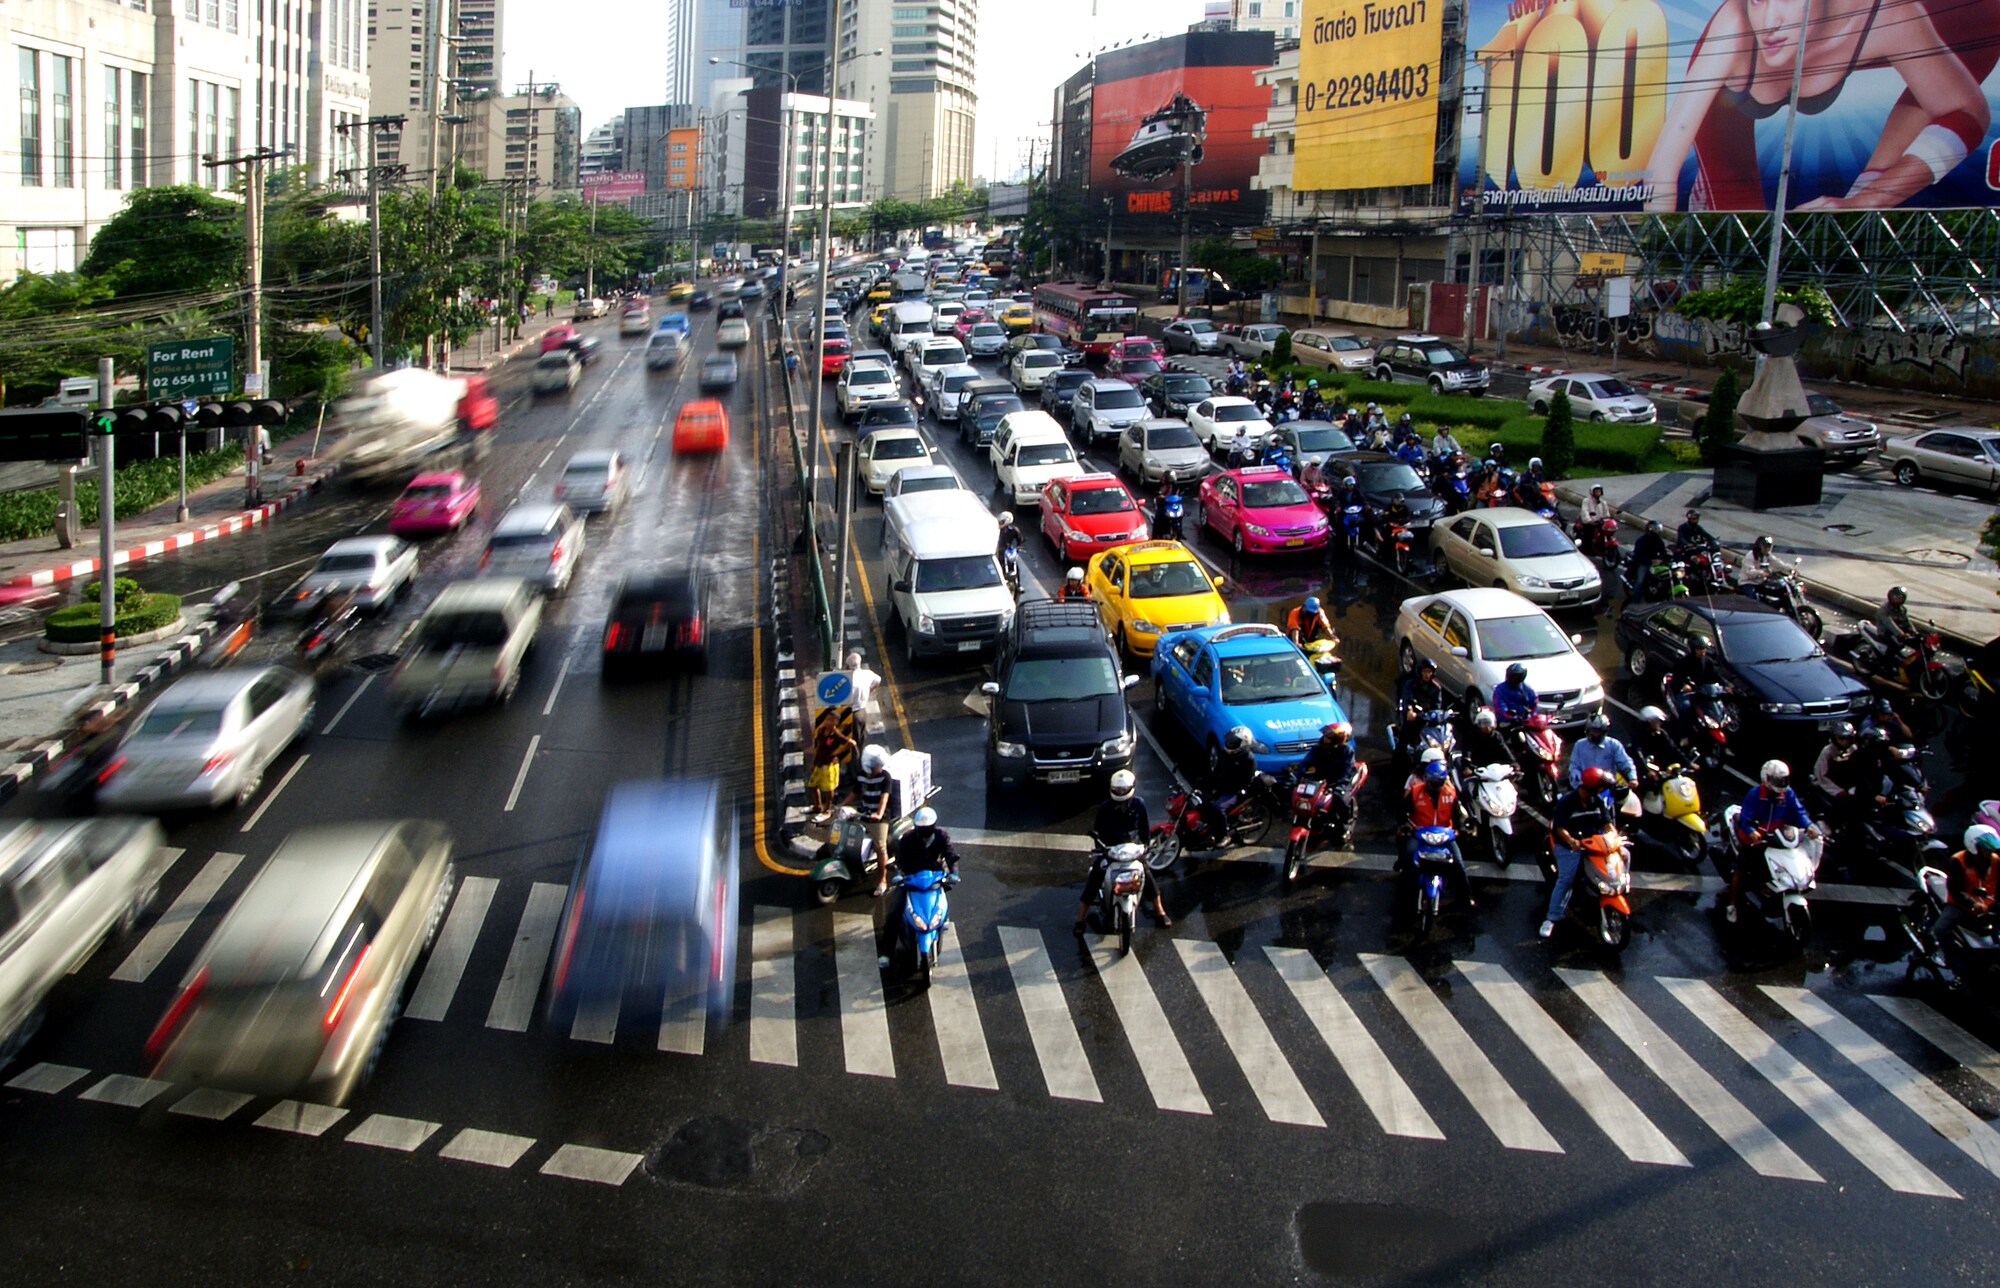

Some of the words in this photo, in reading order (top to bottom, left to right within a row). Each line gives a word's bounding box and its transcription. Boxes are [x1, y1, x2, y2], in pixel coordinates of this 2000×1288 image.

[1313, 10, 1357, 45] ติดต่อ
[1305, 63, 1429, 112] 0-22294403
[1127, 191, 1172, 212] CHIVAS
[1188, 189, 1240, 203] CHIVAS
[153, 351, 177, 362] For
[181, 347, 214, 360] Rent
[152, 377, 169, 387] 02
[172, 374, 195, 386] 654
[200, 371, 228, 382] 1111
